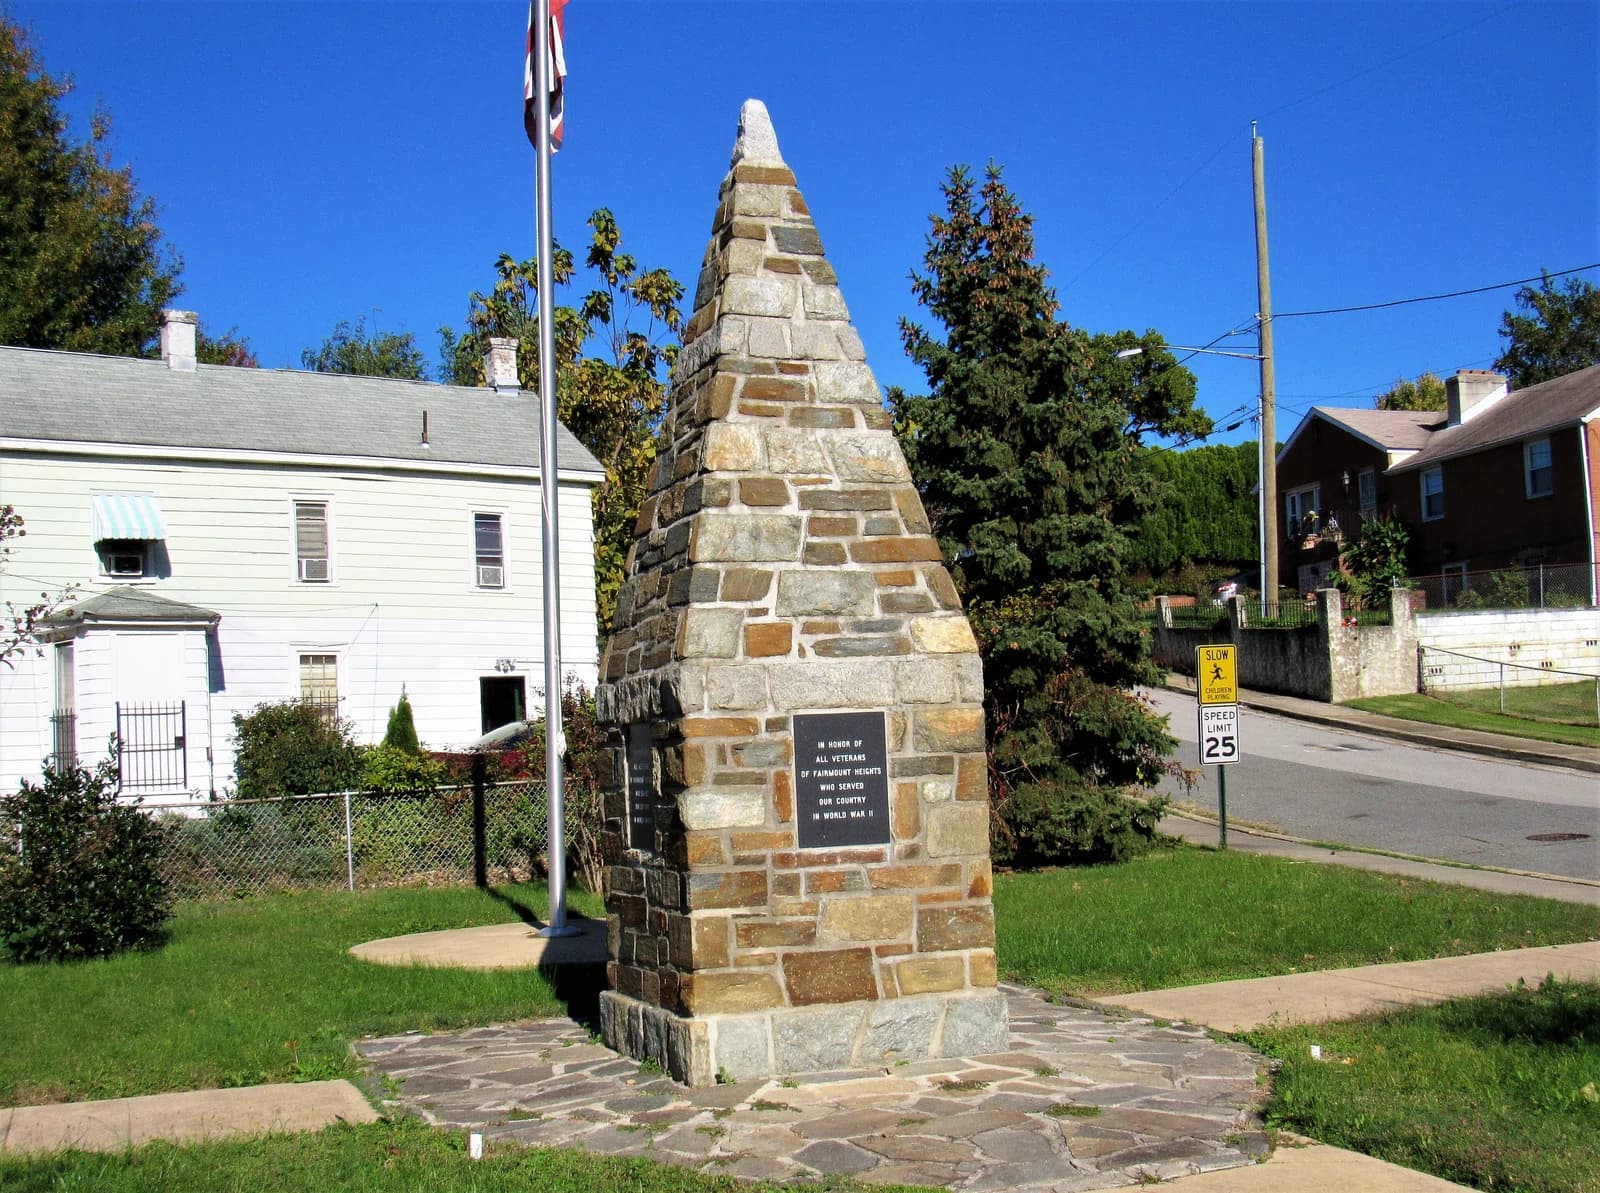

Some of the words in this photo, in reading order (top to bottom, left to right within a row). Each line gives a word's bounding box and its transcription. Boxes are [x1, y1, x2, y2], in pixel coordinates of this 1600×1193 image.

[1206, 650, 1228, 660] SLOW
[1204, 711, 1235, 720] SPEED
[1208, 724, 1232, 733] LIMIT
[1206, 736, 1235, 758] 25
[832, 754, 866, 762] VETERANS
[813, 769, 851, 777] FAIRMOUNT
[855, 767, 881, 775] HEIGHTS
[836, 797, 866, 805] COUNTRY
[824, 811, 846, 820] WORLD
[850, 810, 865, 818] WAR
